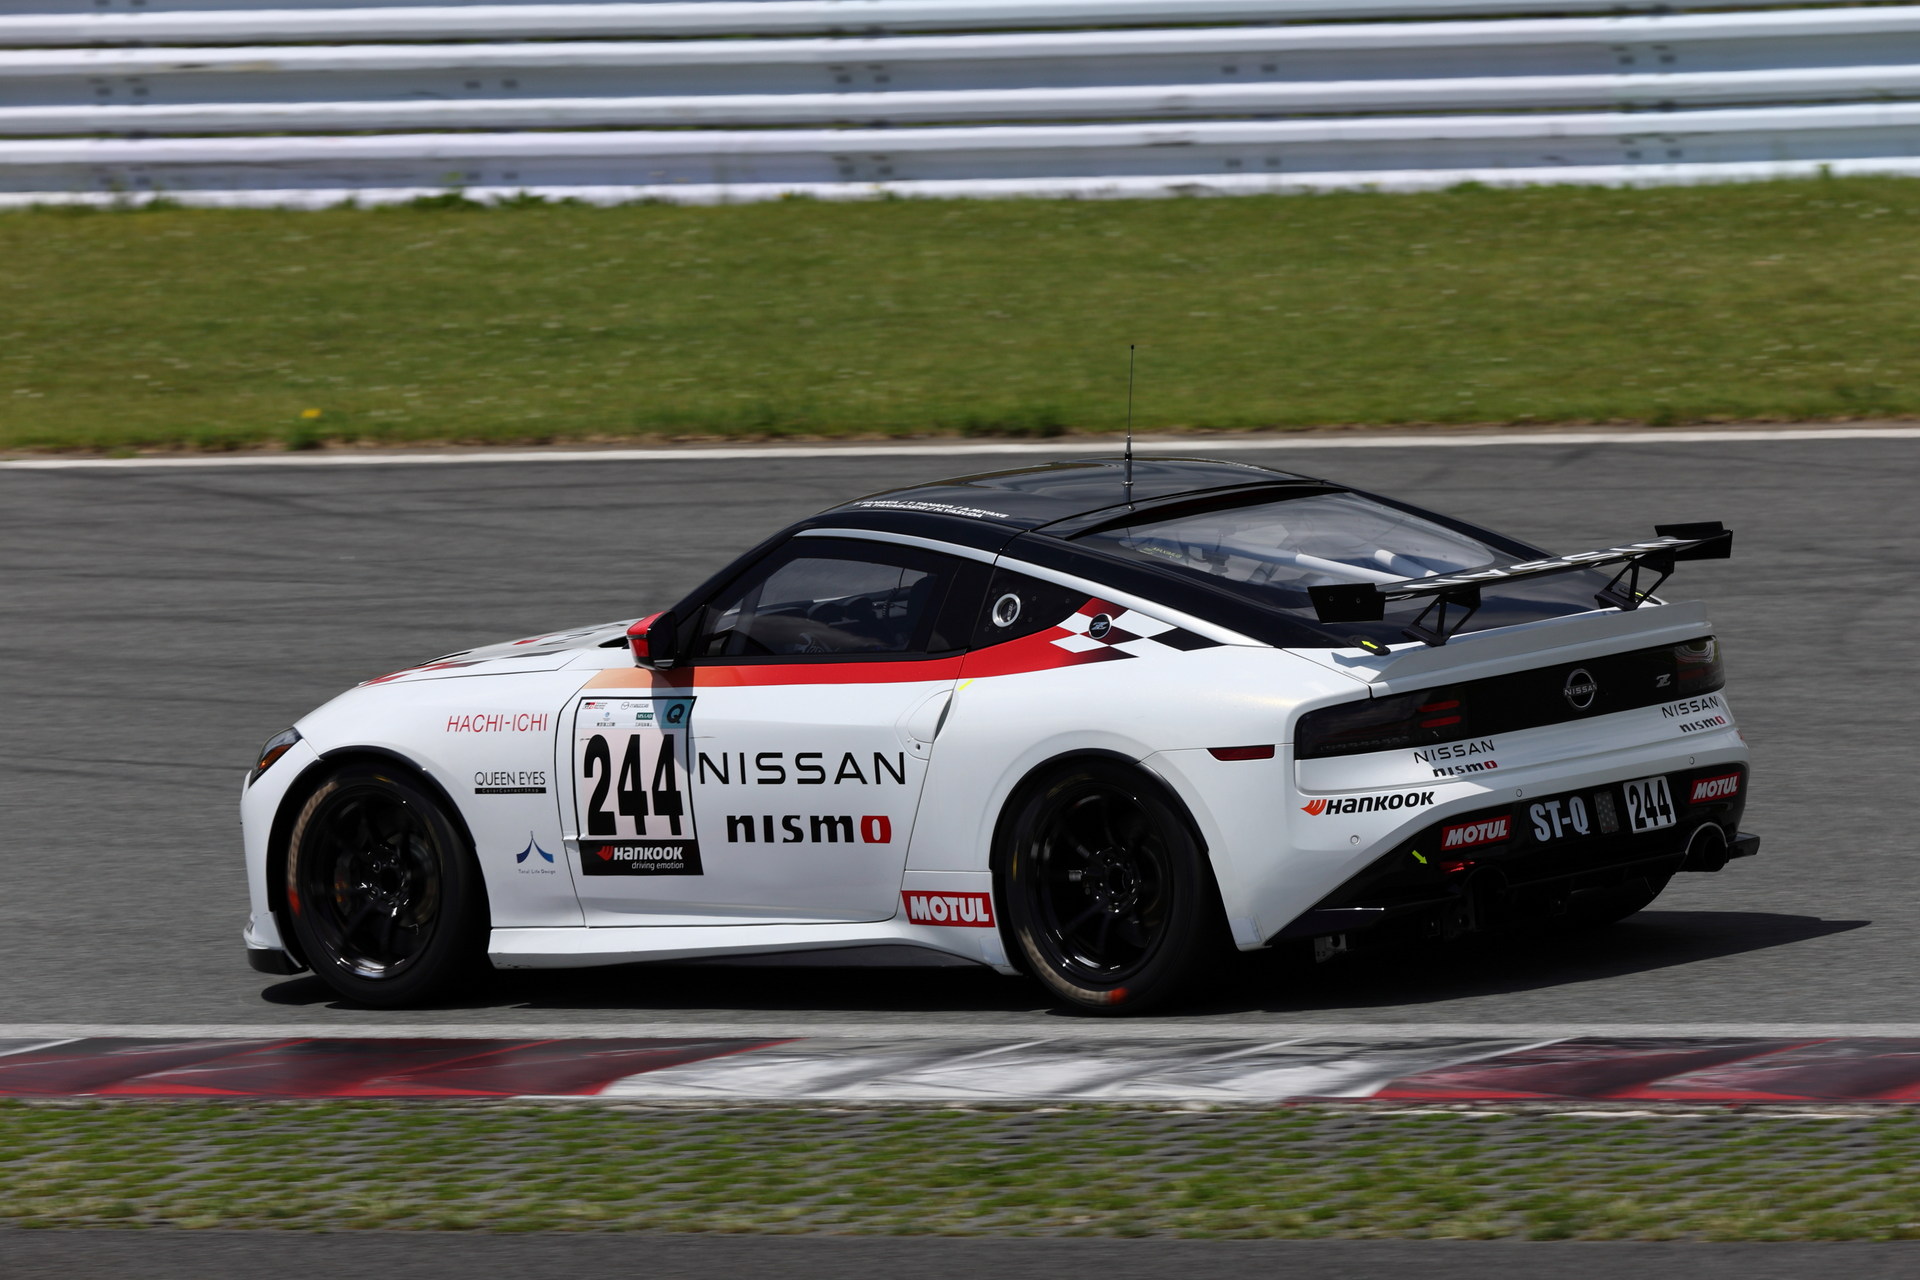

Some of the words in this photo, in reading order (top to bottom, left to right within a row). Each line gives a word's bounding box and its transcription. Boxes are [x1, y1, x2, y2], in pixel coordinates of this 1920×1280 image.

[1564, 684, 1598, 697] NISSAN
[667, 703, 686, 724] Q
[1661, 696, 1720, 719] NISSAN
[446, 713, 548, 733] HACHI-ICHI
[1680, 715, 1727, 733] nismo
[1413, 739, 1496, 764] NISSAN
[474, 771, 516, 786] QUEEN
[519, 771, 546, 786] EYES
[698, 751, 906, 785] NISSAN
[1432, 760, 1498, 778] nismo
[583, 734, 684, 836] 244
[1693, 775, 1738, 800] MOTUL
[1629, 779, 1672, 830] 244
[726, 814, 892, 844] nismo
[1529, 796, 1591, 842] ST-Q
[1445, 819, 1507, 847] MOTUL
[631, 860, 656, 871] driving
[656, 860, 685, 870] emotion
[909, 895, 990, 923] MOTUL
